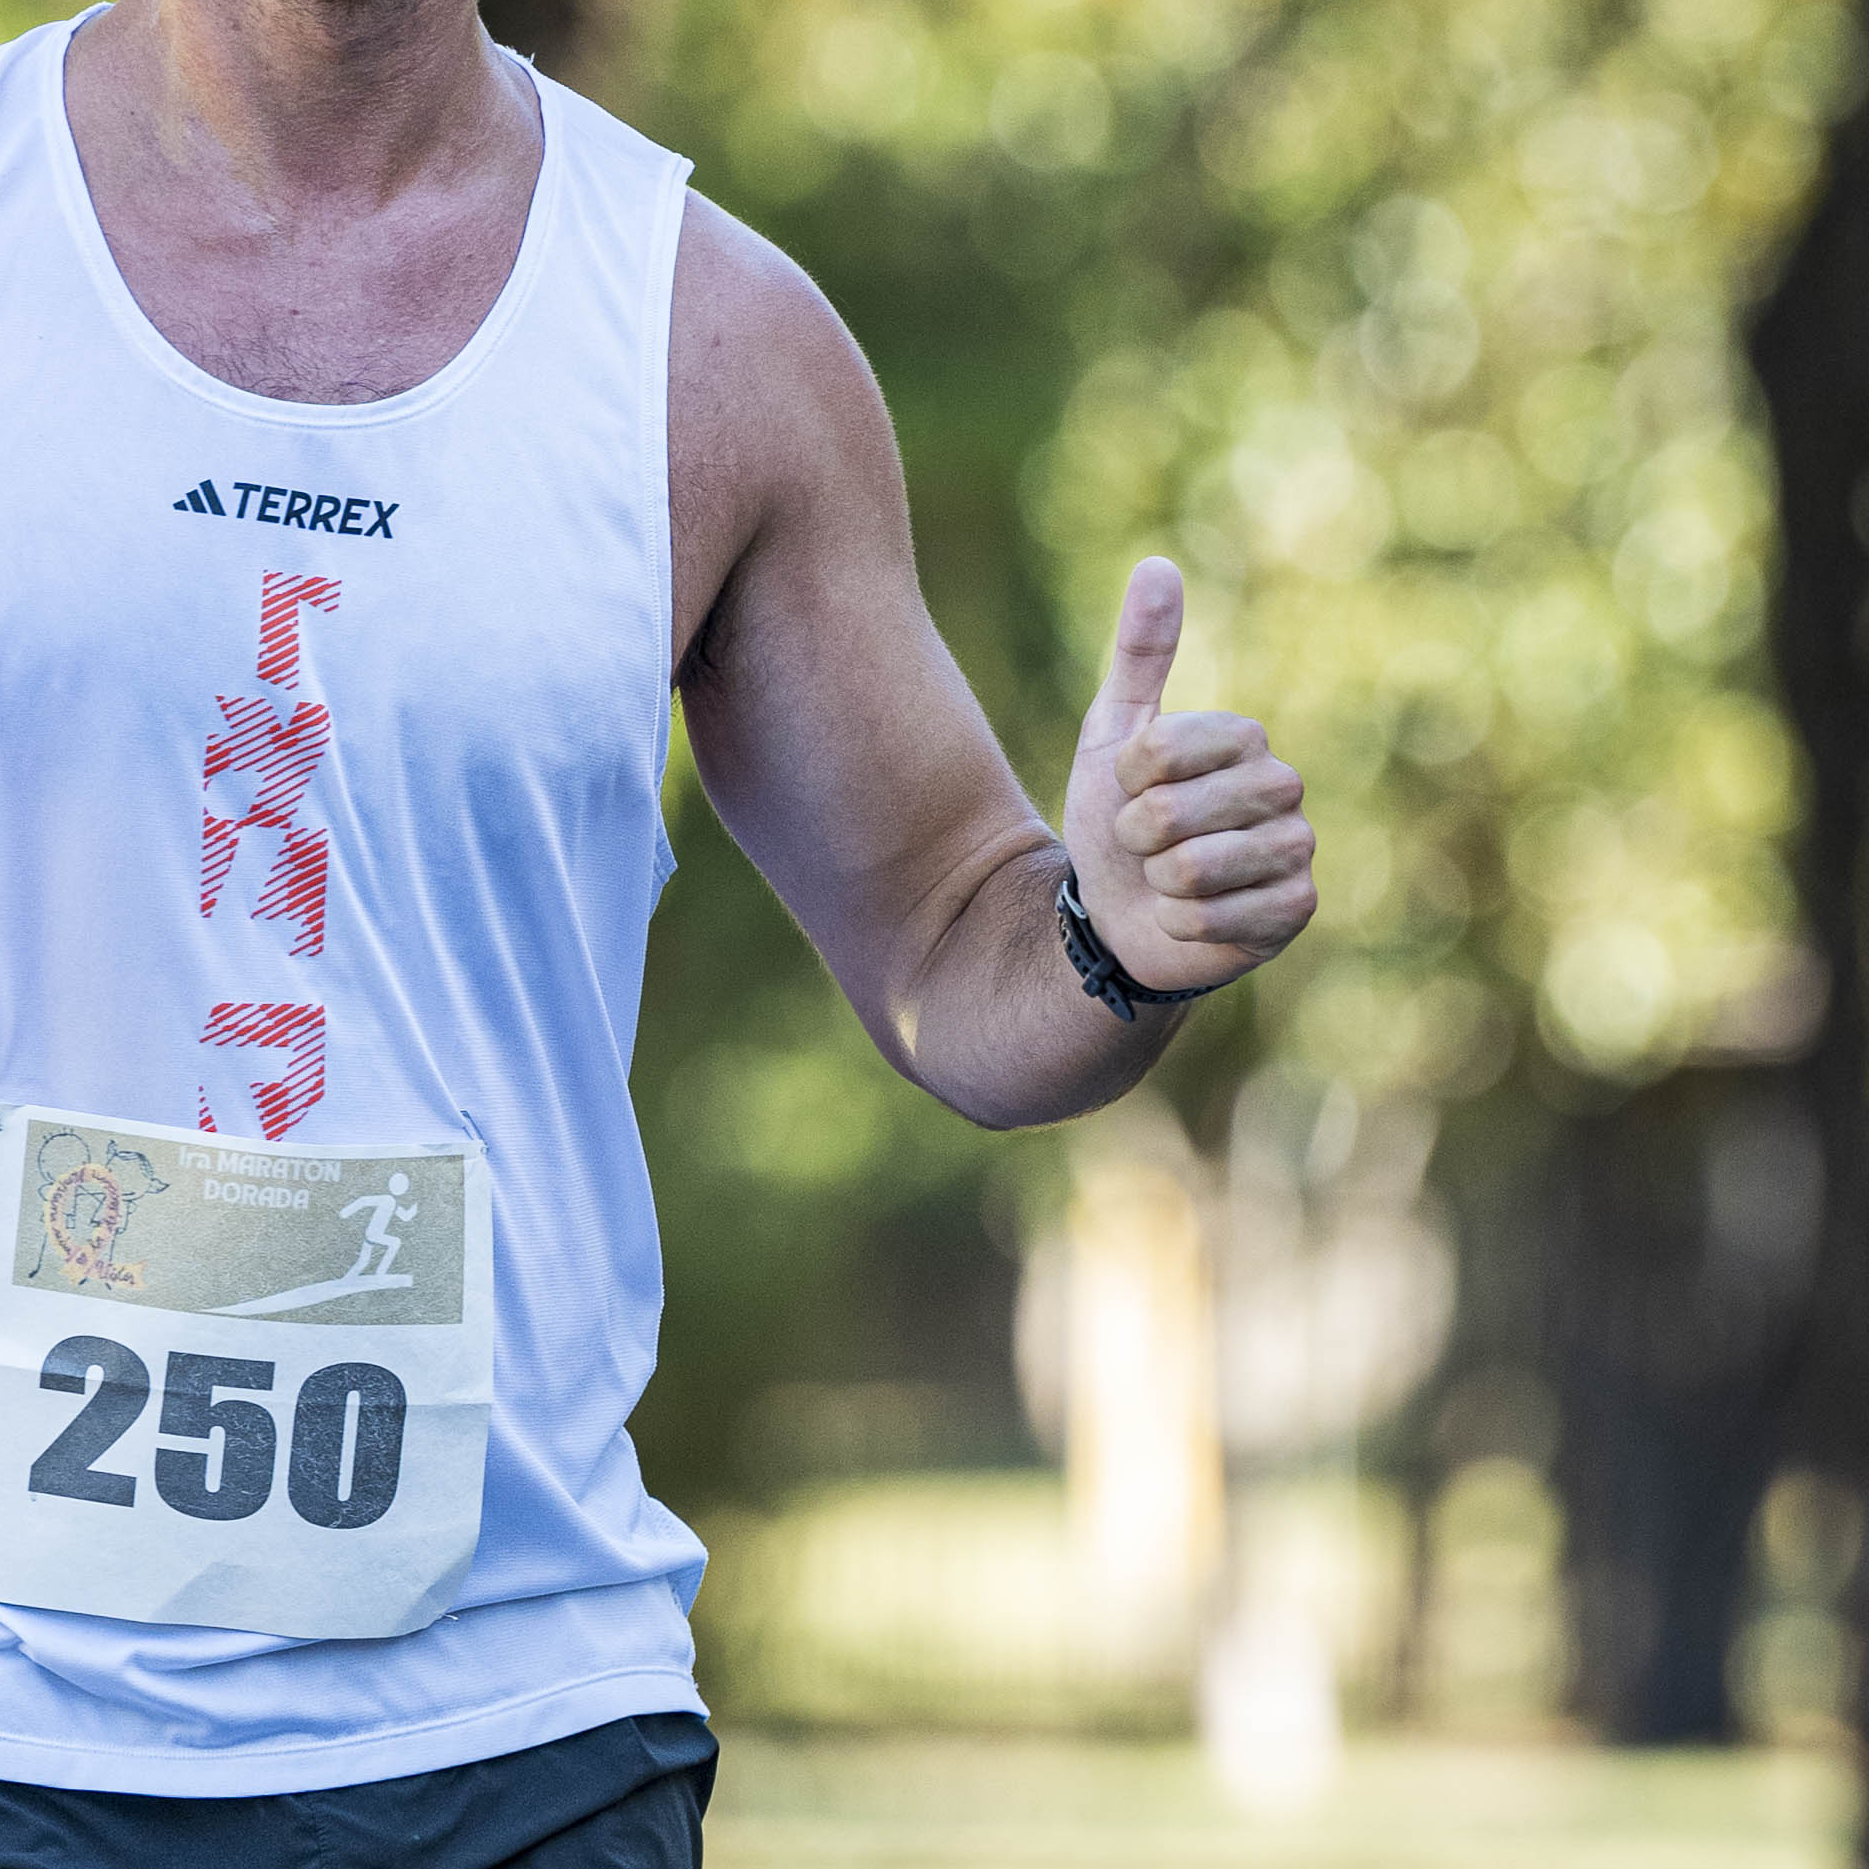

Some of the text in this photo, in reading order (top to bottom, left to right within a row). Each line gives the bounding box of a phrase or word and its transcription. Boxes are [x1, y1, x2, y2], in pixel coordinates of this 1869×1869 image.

[233, 482, 400, 539] TERREX
[217, 1150, 341, 1182] MARATON
[204, 1179, 310, 1210] DORADA
[28, 1335, 407, 1530] 250
